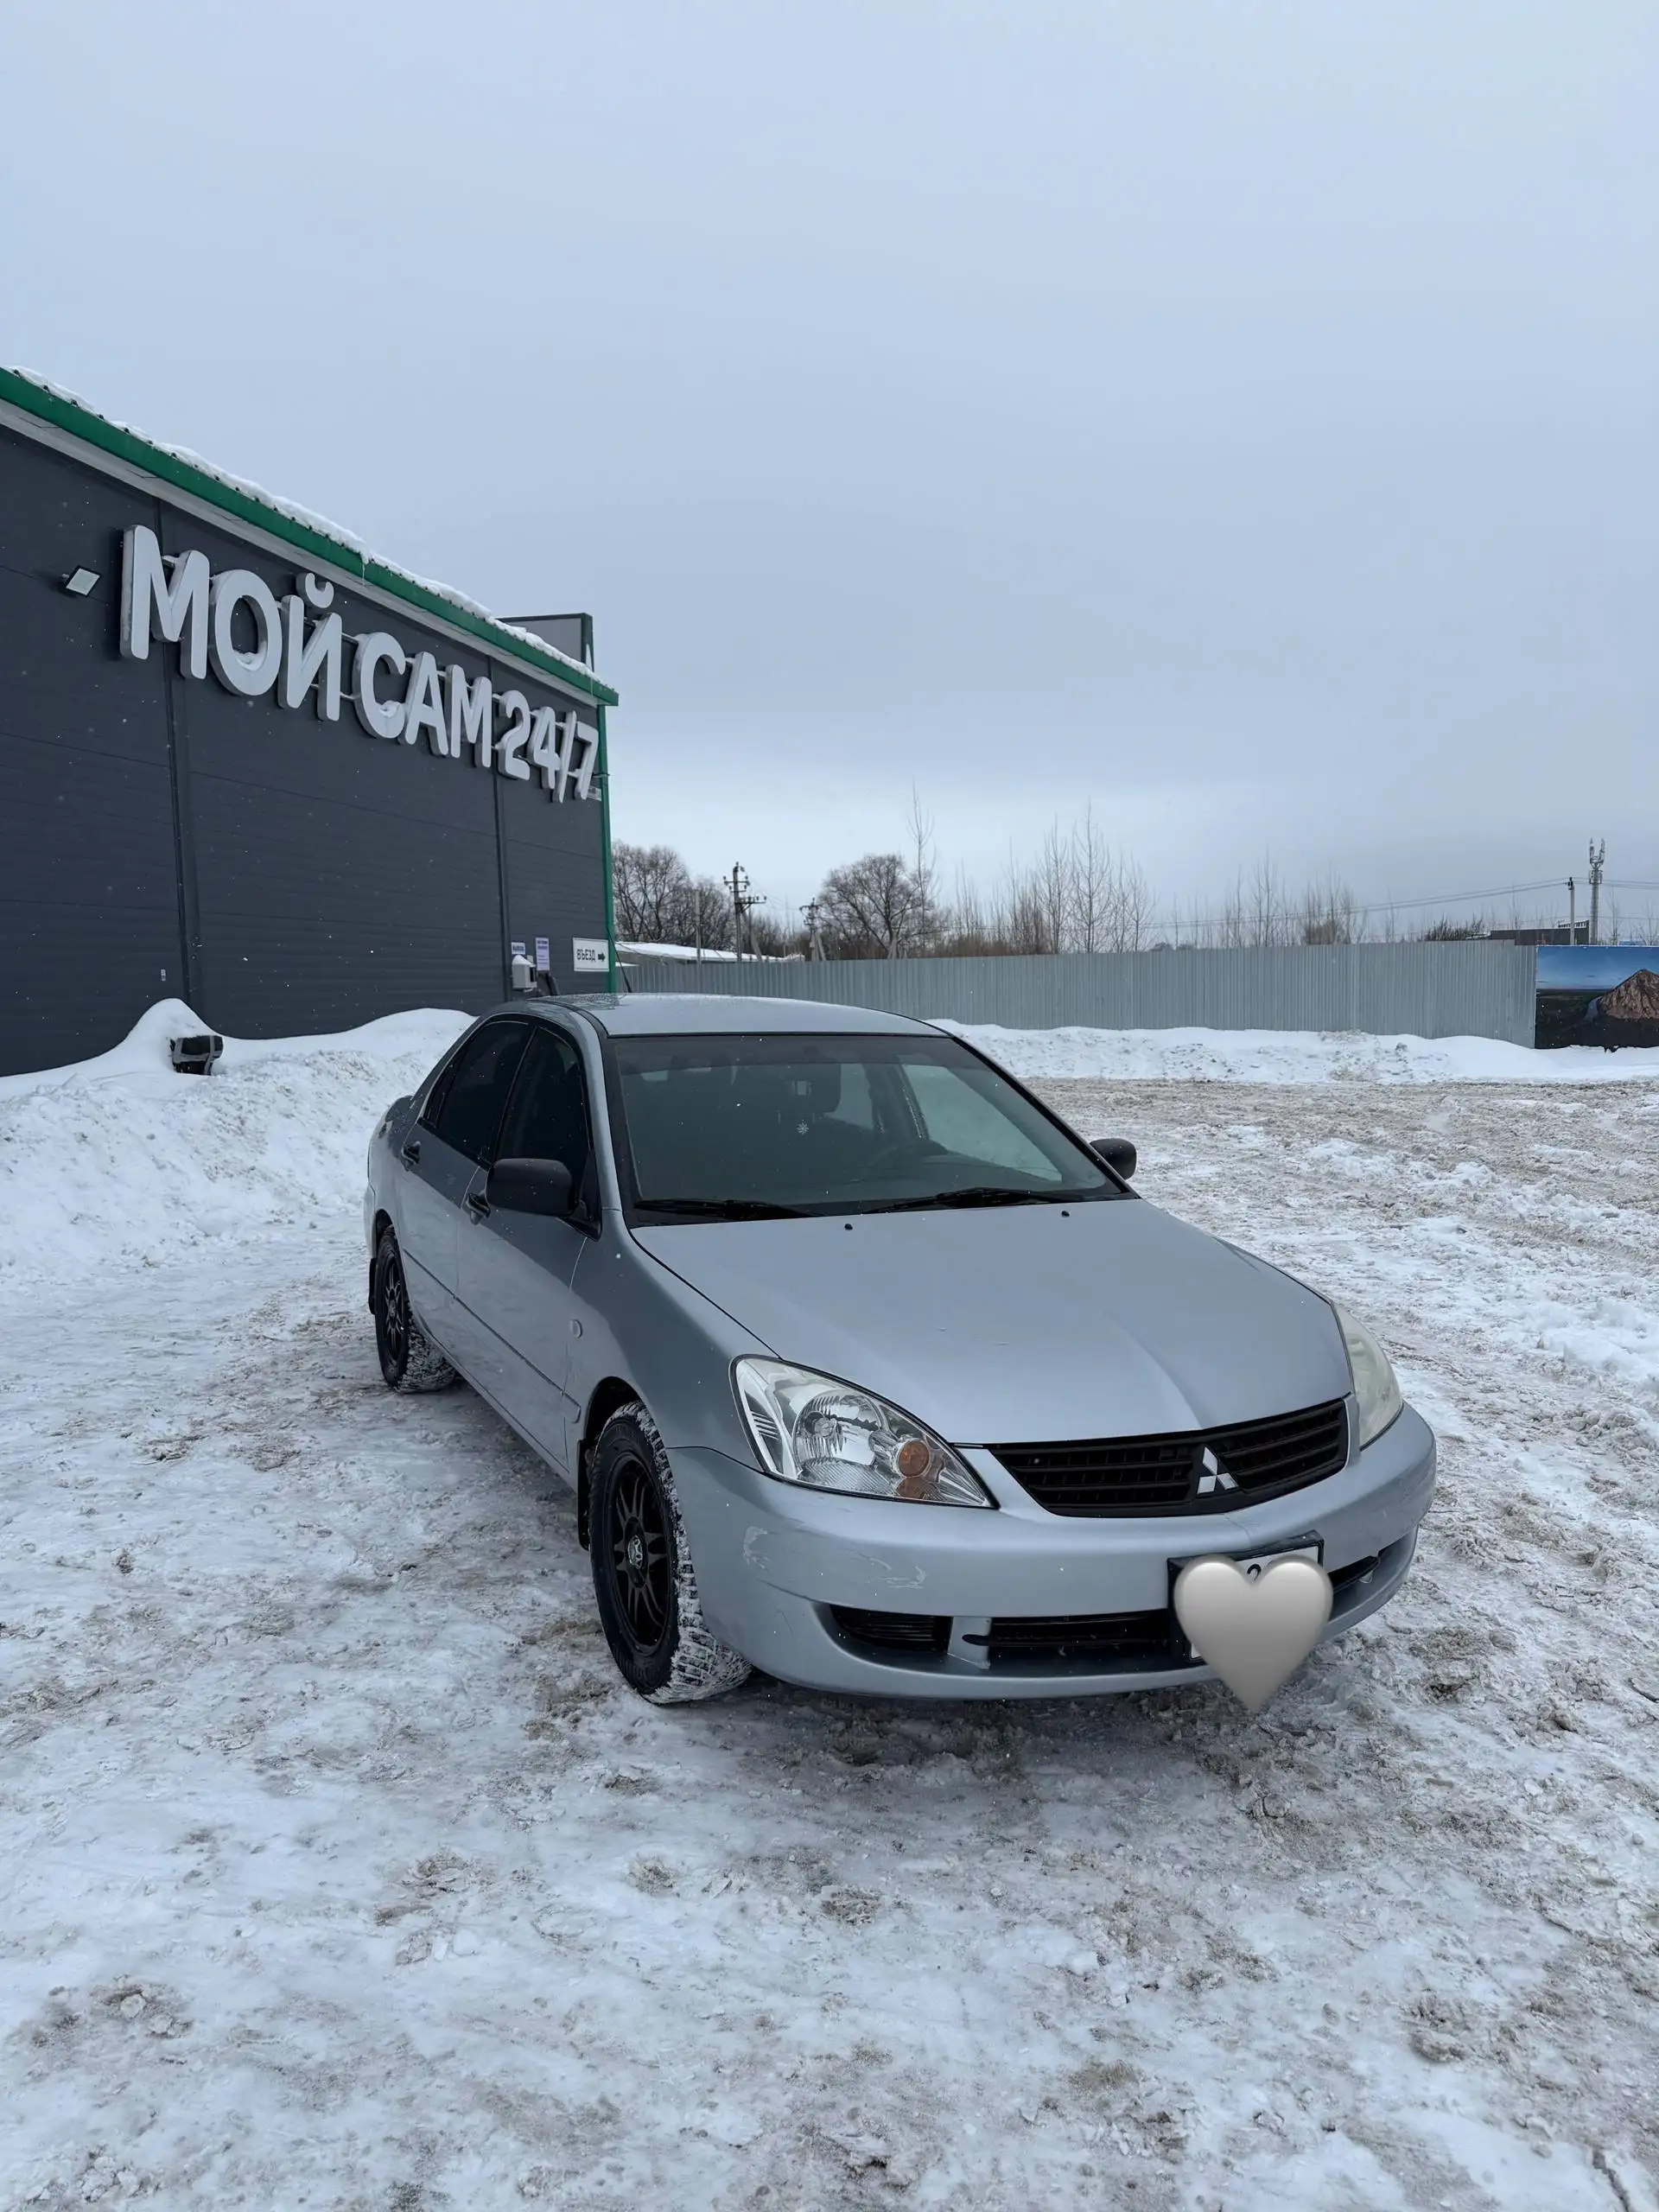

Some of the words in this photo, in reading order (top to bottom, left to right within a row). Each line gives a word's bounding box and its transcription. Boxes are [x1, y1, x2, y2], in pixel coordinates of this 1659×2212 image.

[122, 525, 342, 721] МОЙ
[354, 632, 492, 767] САМ
[499, 690, 599, 804] 24/7
[576, 949, 595, 963] ВЪЕЗД
